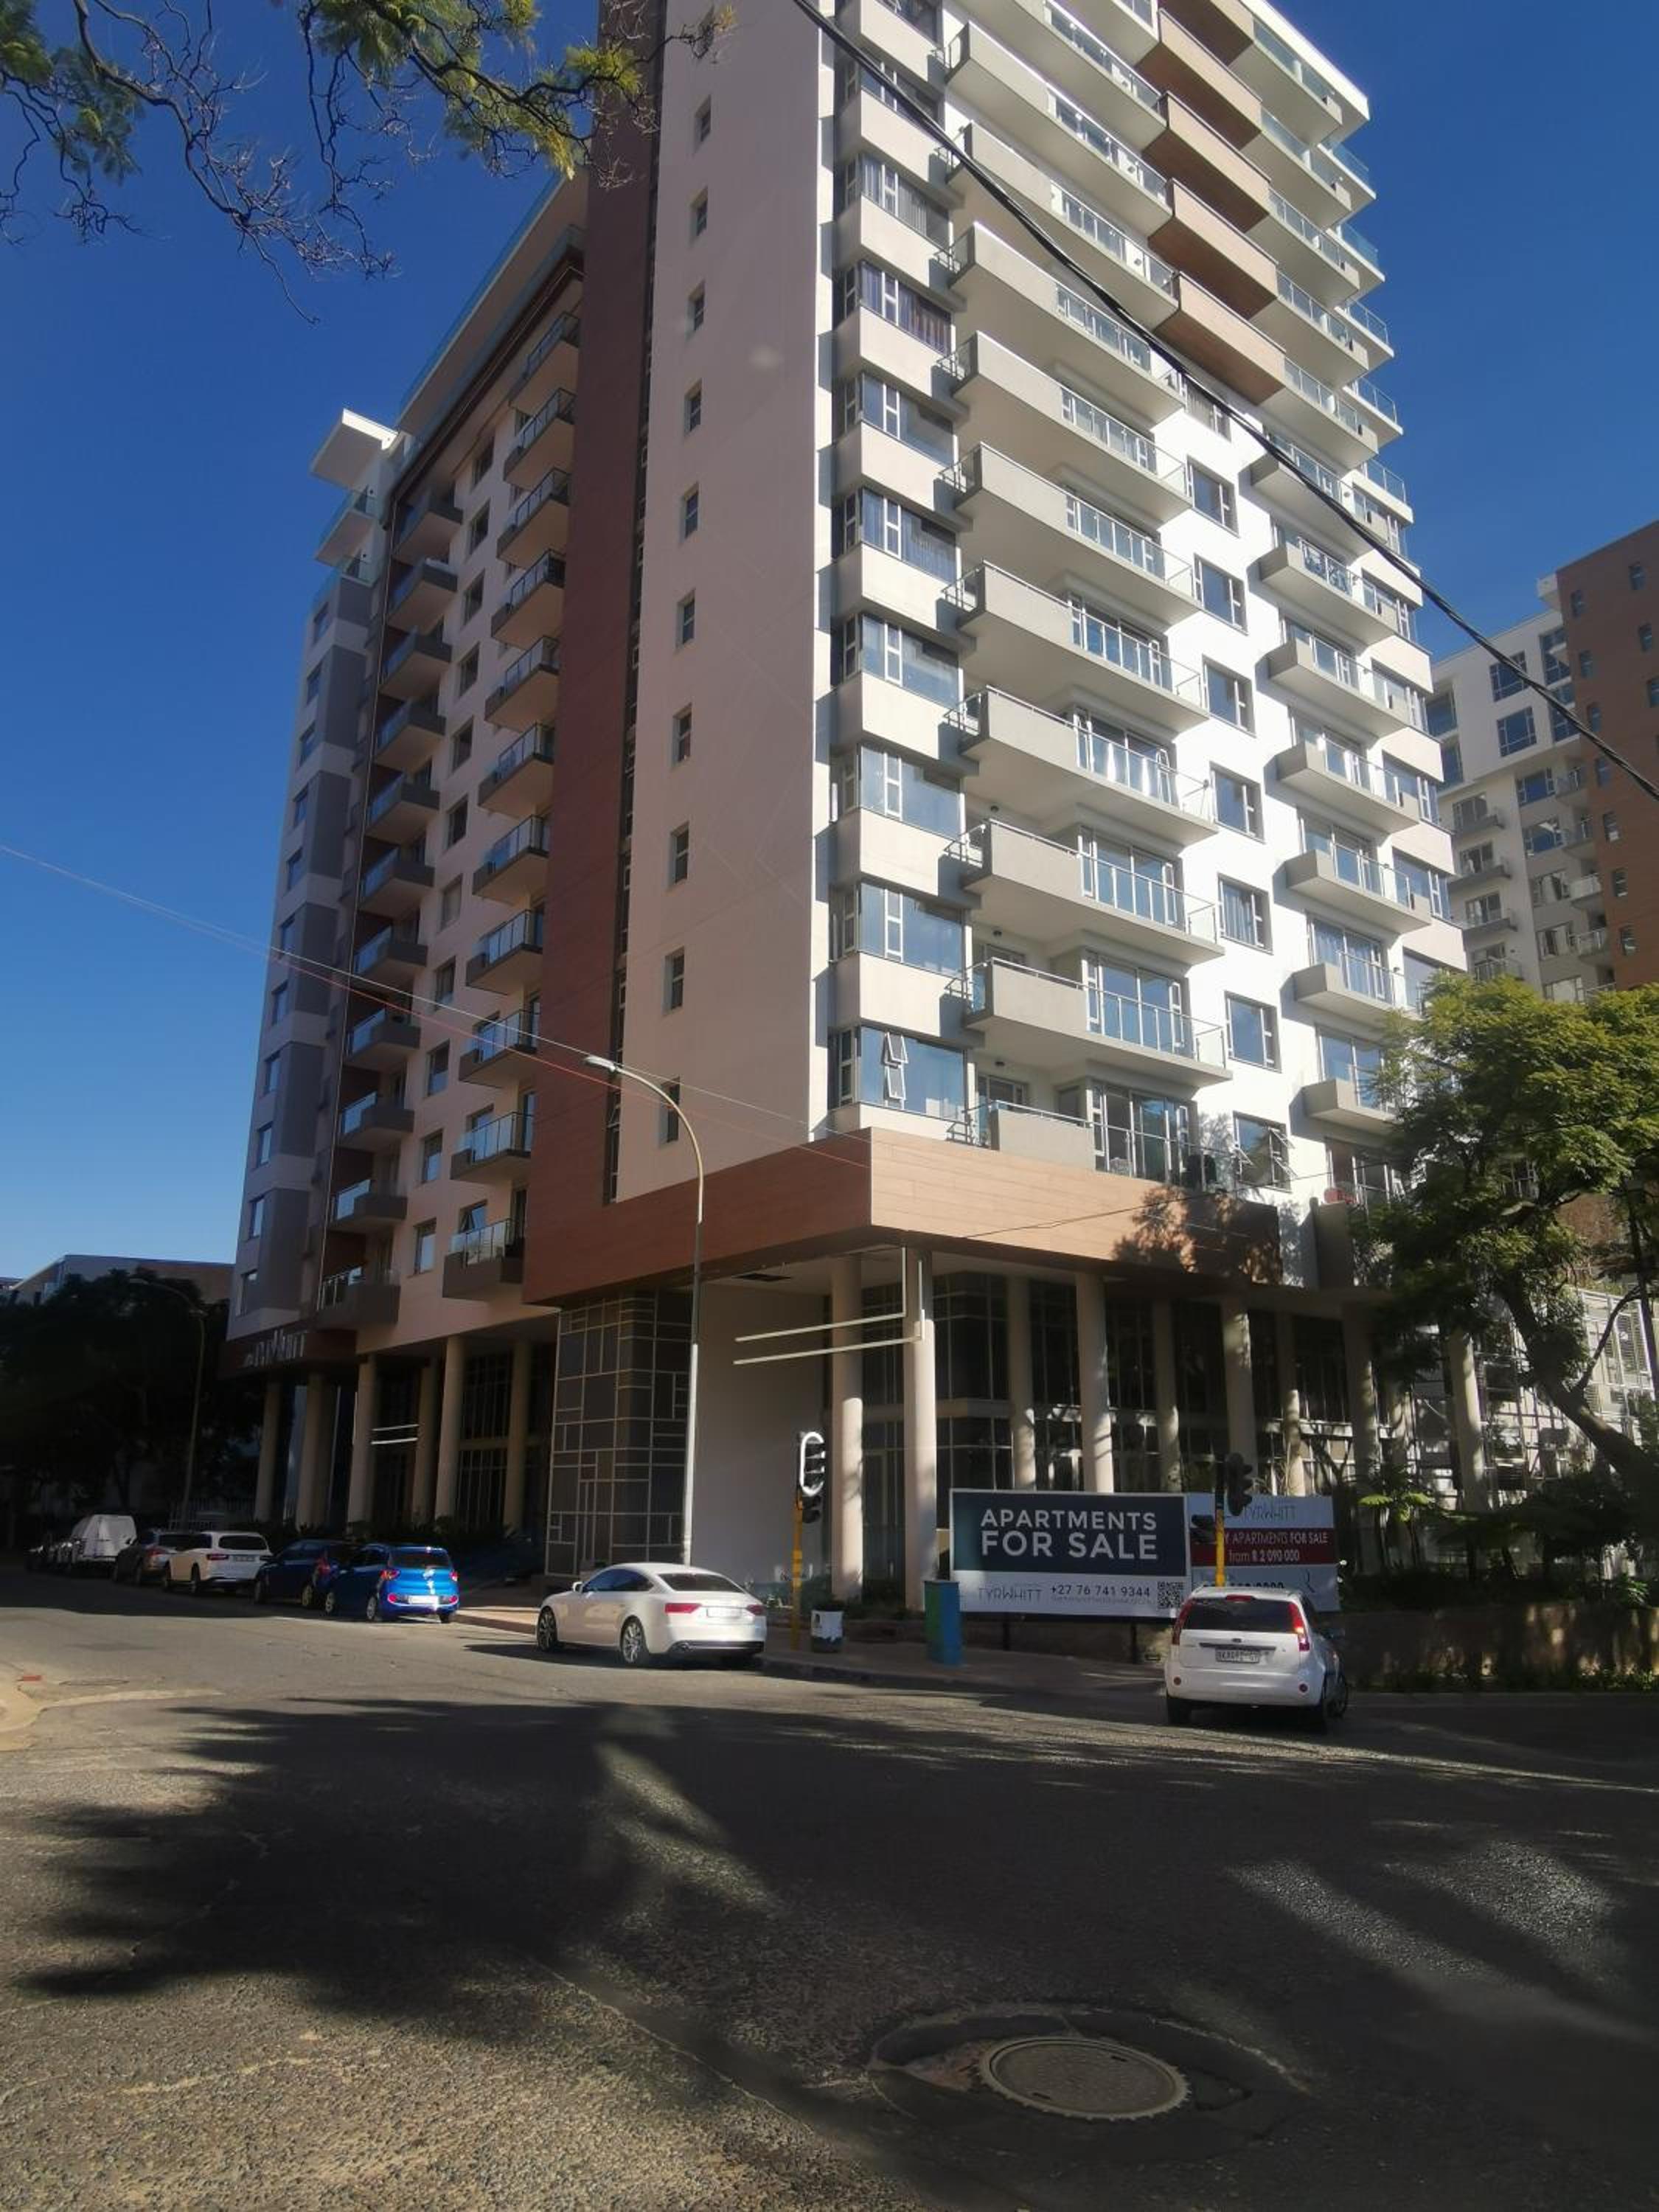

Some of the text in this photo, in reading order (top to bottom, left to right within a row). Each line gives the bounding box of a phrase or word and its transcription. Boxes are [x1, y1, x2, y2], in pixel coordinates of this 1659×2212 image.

[980, 1509, 1157, 1530] APARTMENTS
[981, 1530, 1158, 1559] FOR SALE
[1232, 1531, 1288, 1545] APARTMENTS
[1290, 1531, 1307, 1545] FOR
[1308, 1531, 1328, 1545] SALE
[1228, 1549, 1250, 1562] from
[1050, 1585, 1150, 1598] +27 76 741 9344
